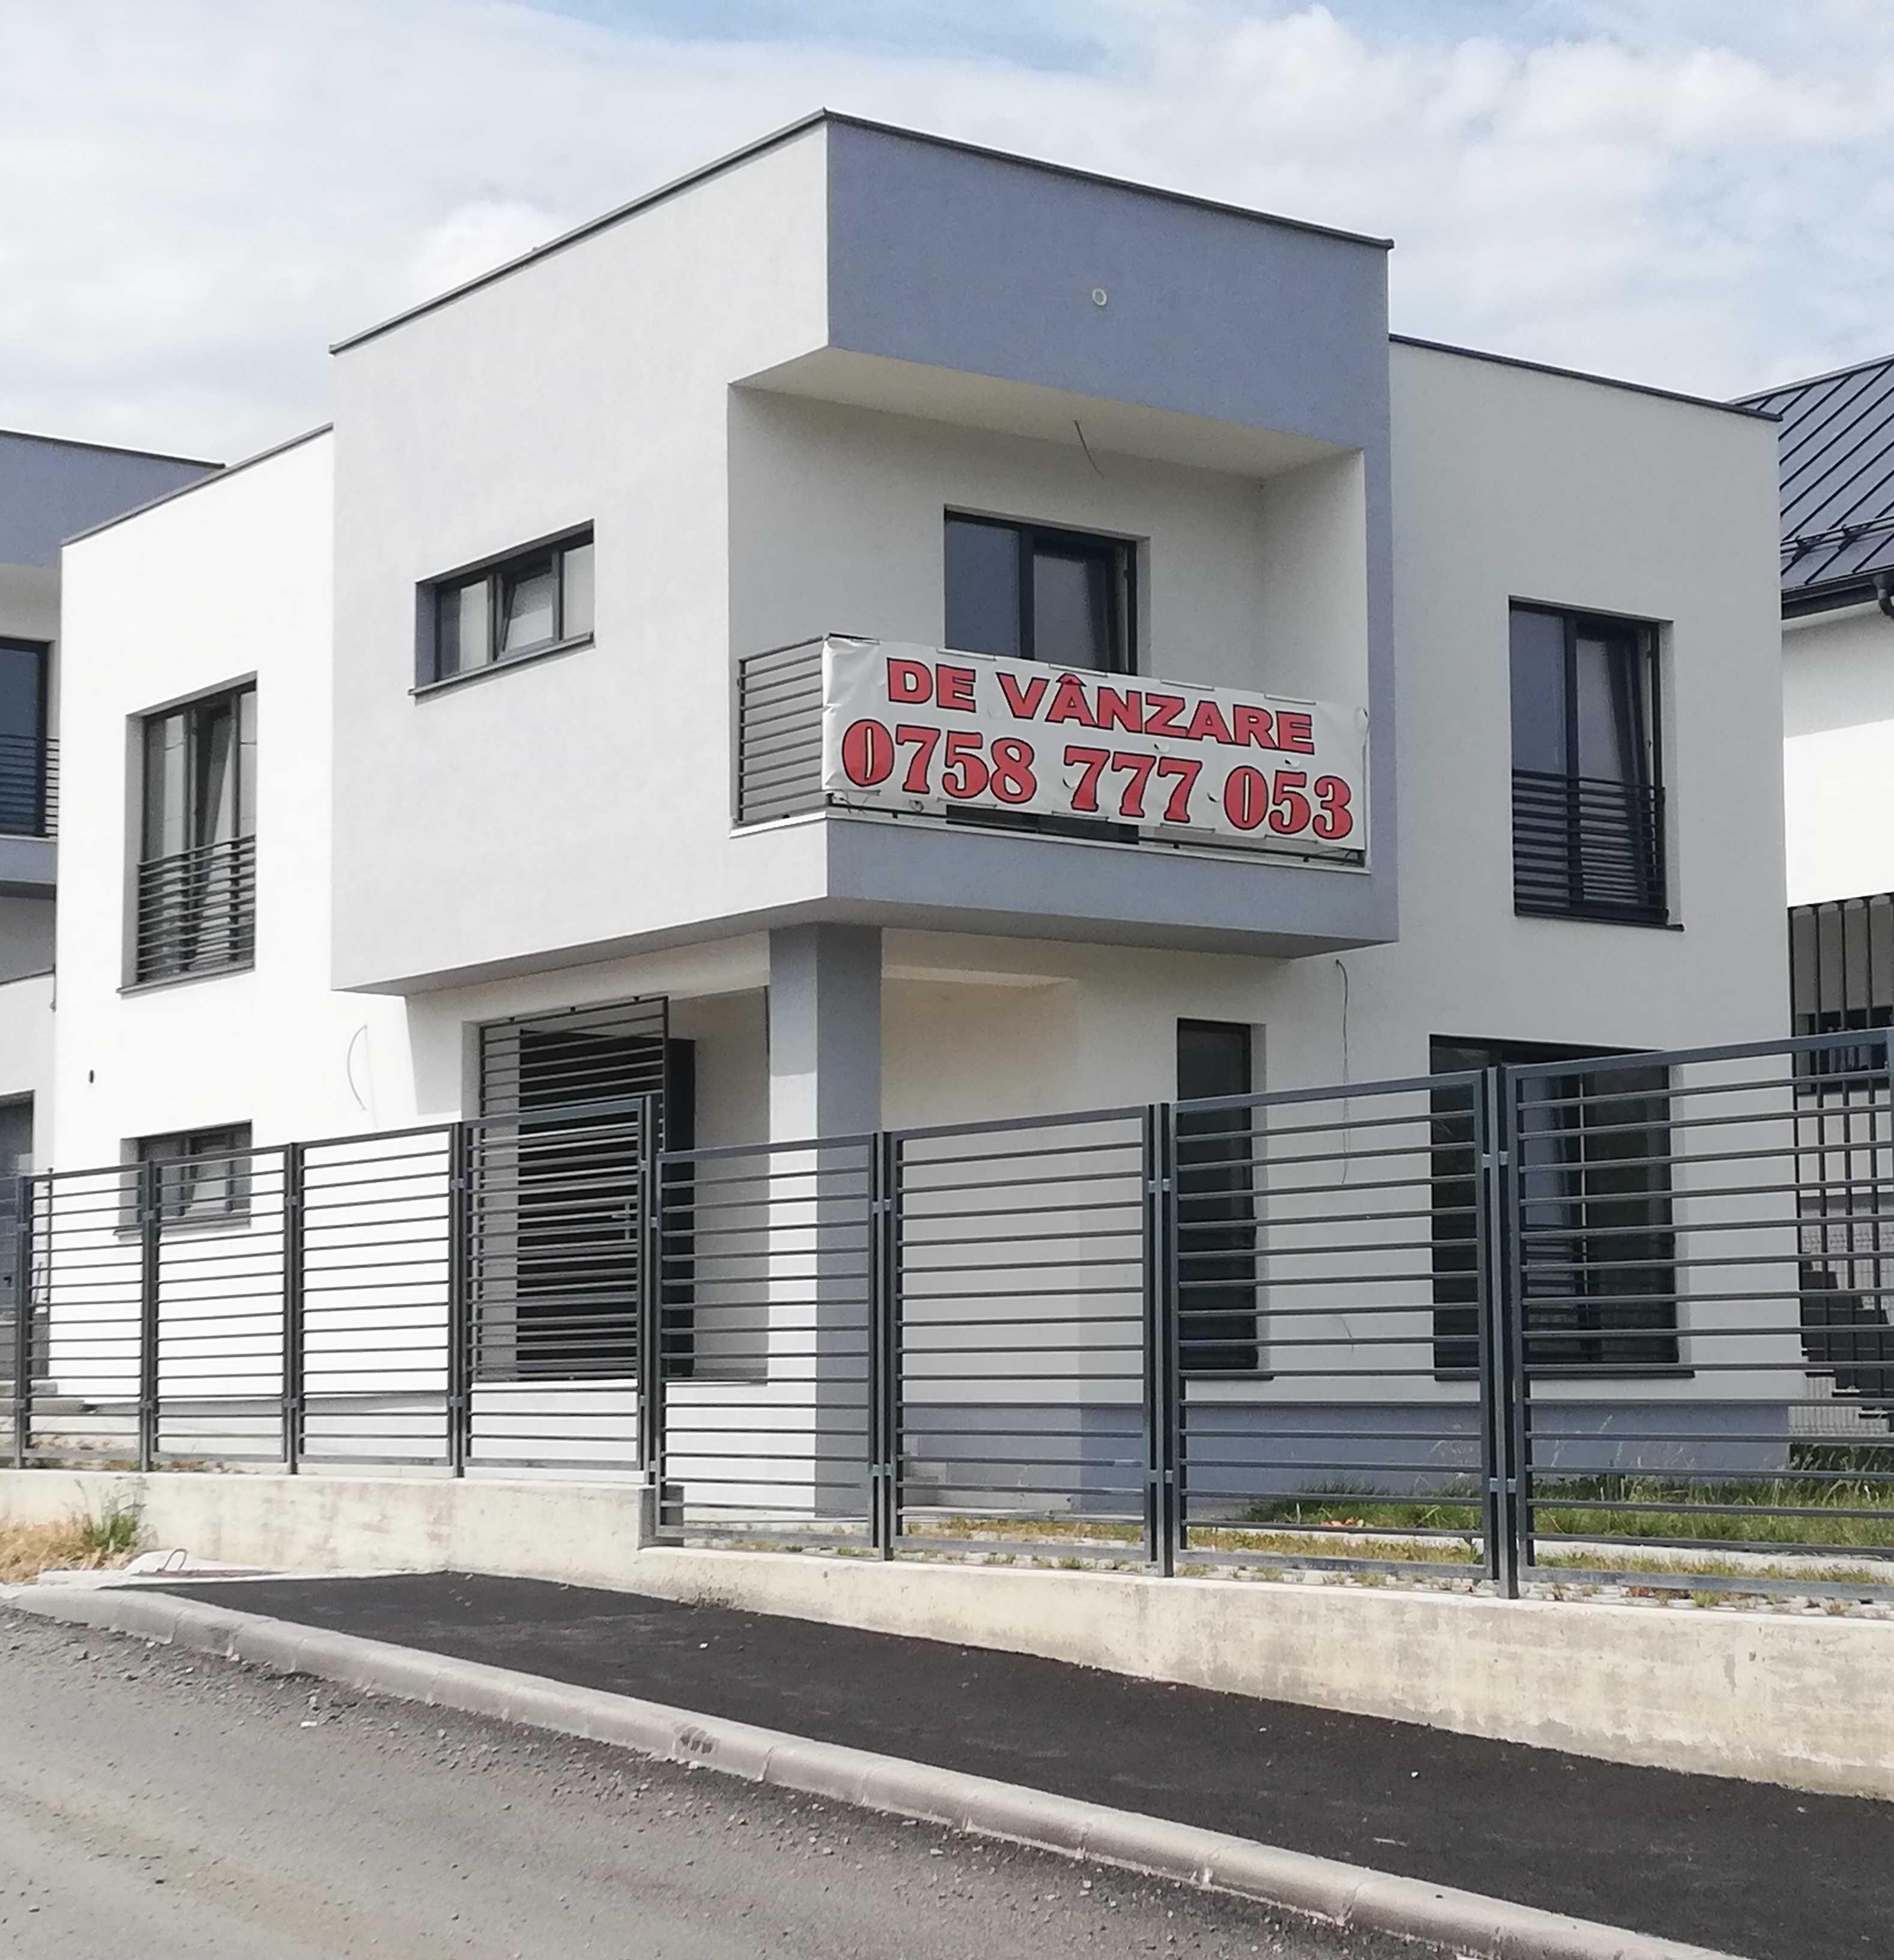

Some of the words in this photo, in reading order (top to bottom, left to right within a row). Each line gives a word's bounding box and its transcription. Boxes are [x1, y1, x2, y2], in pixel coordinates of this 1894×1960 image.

[886, 658, 976, 712] DE
[995, 673, 1315, 755] VÂNZARE
[841, 719, 1037, 804] 0758
[1063, 745, 1203, 823] 777
[1223, 766, 1354, 840] 053
